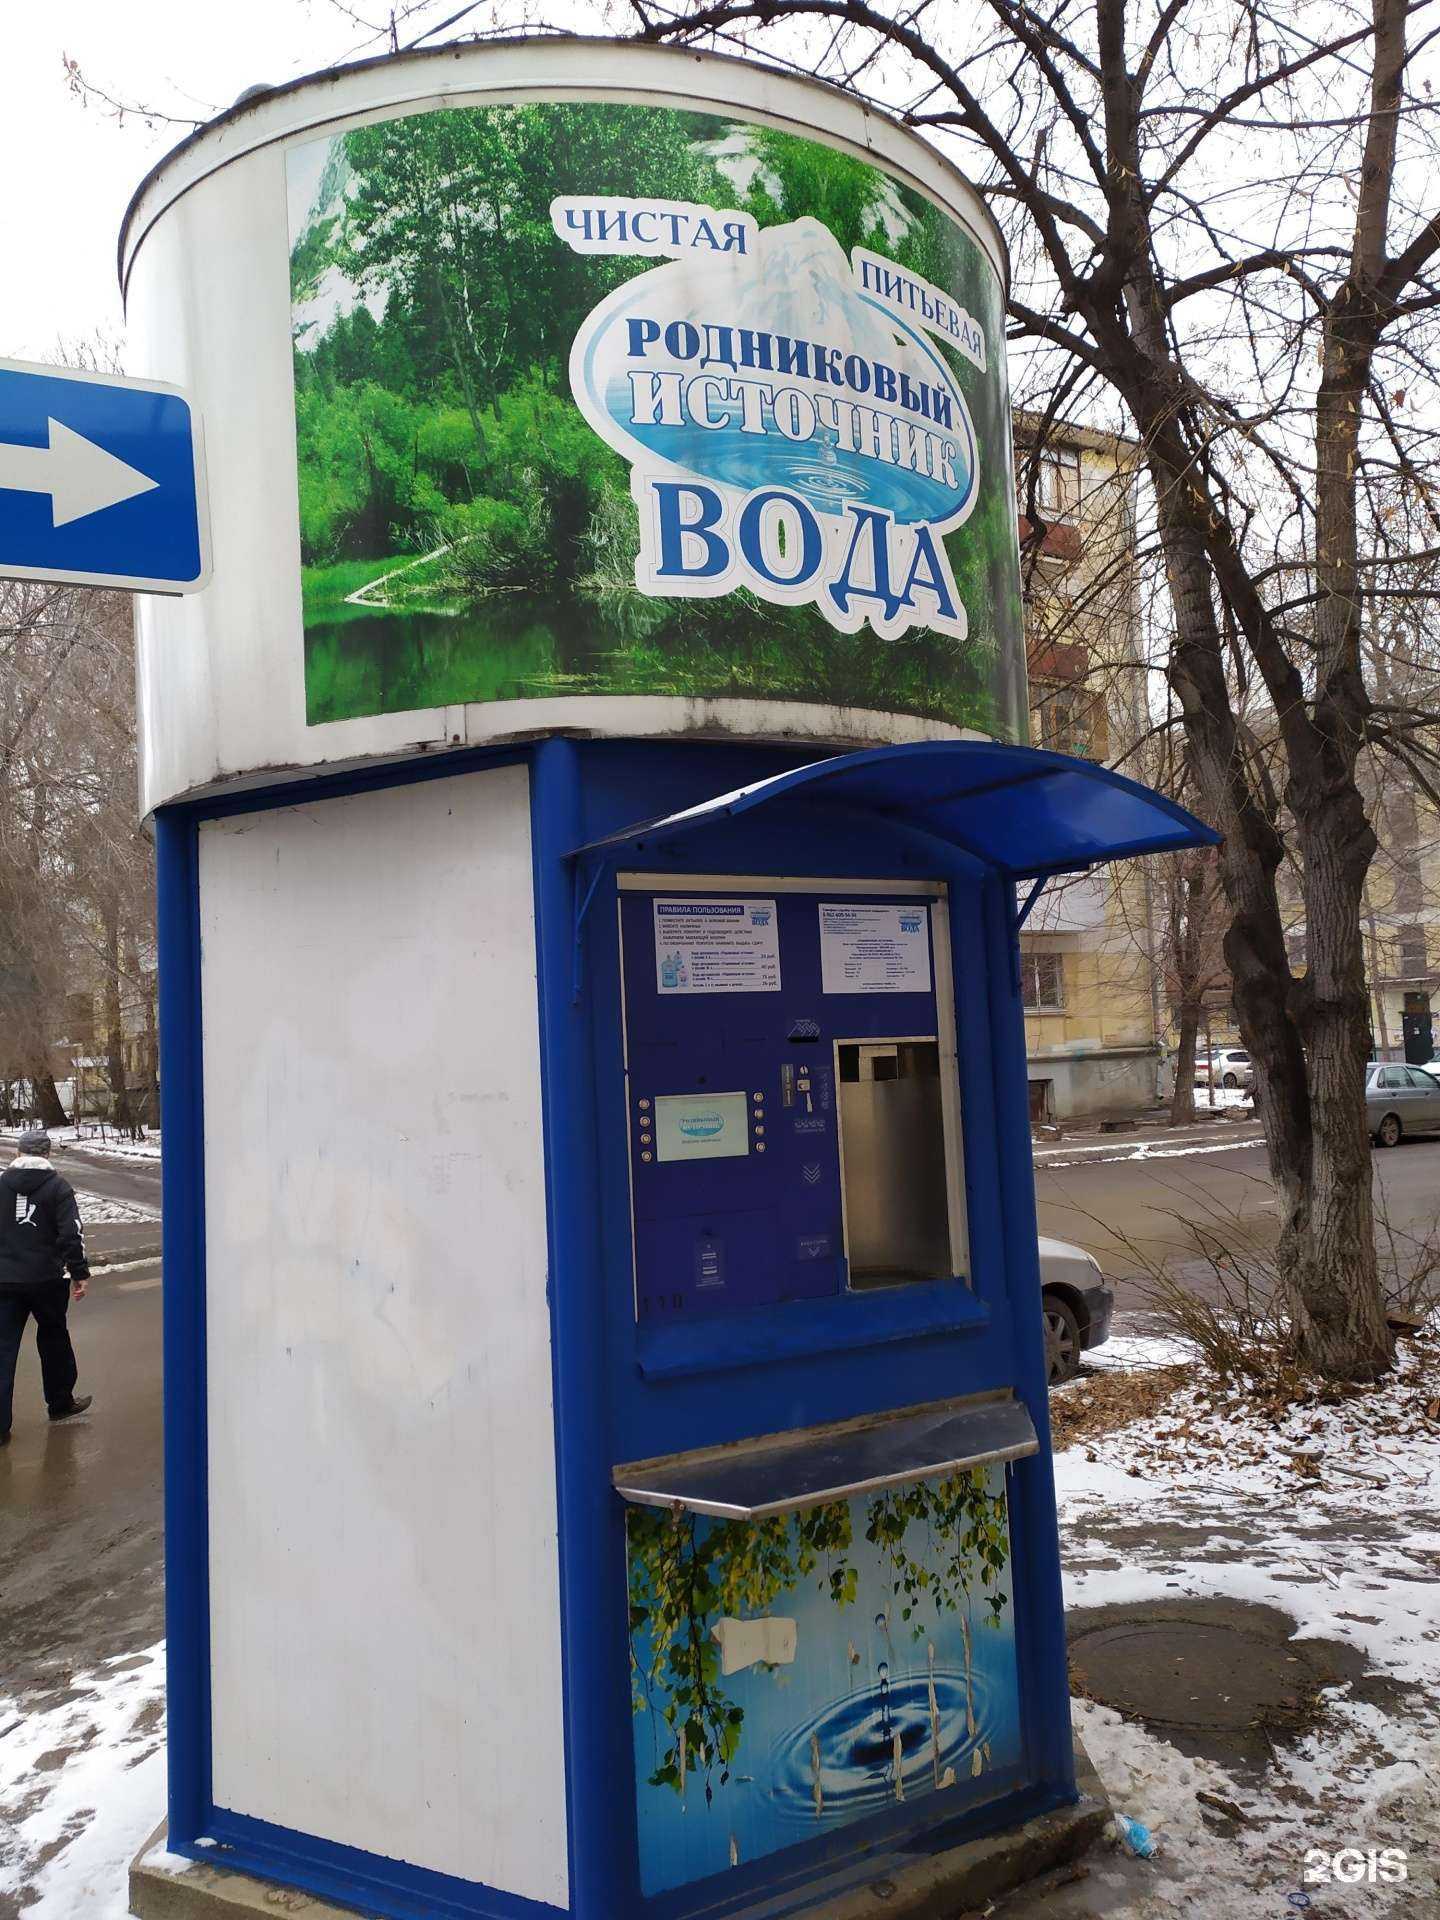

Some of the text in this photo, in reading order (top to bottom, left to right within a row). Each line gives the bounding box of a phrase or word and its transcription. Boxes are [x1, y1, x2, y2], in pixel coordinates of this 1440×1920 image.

[565, 209, 748, 255] ЧИСТАЯ
[861, 259, 983, 360] ПИТЬЕВАЯ
[626, 318, 954, 431] РОДНИКОВЫЙ
[629, 371, 960, 490] ИСТОЧНИК
[651, 481, 959, 622] ВОДА
[659, 905, 691, 914] ПРАВИЛА
[692, 906, 741, 914] ПОЛЬЗОВАНИЯ
